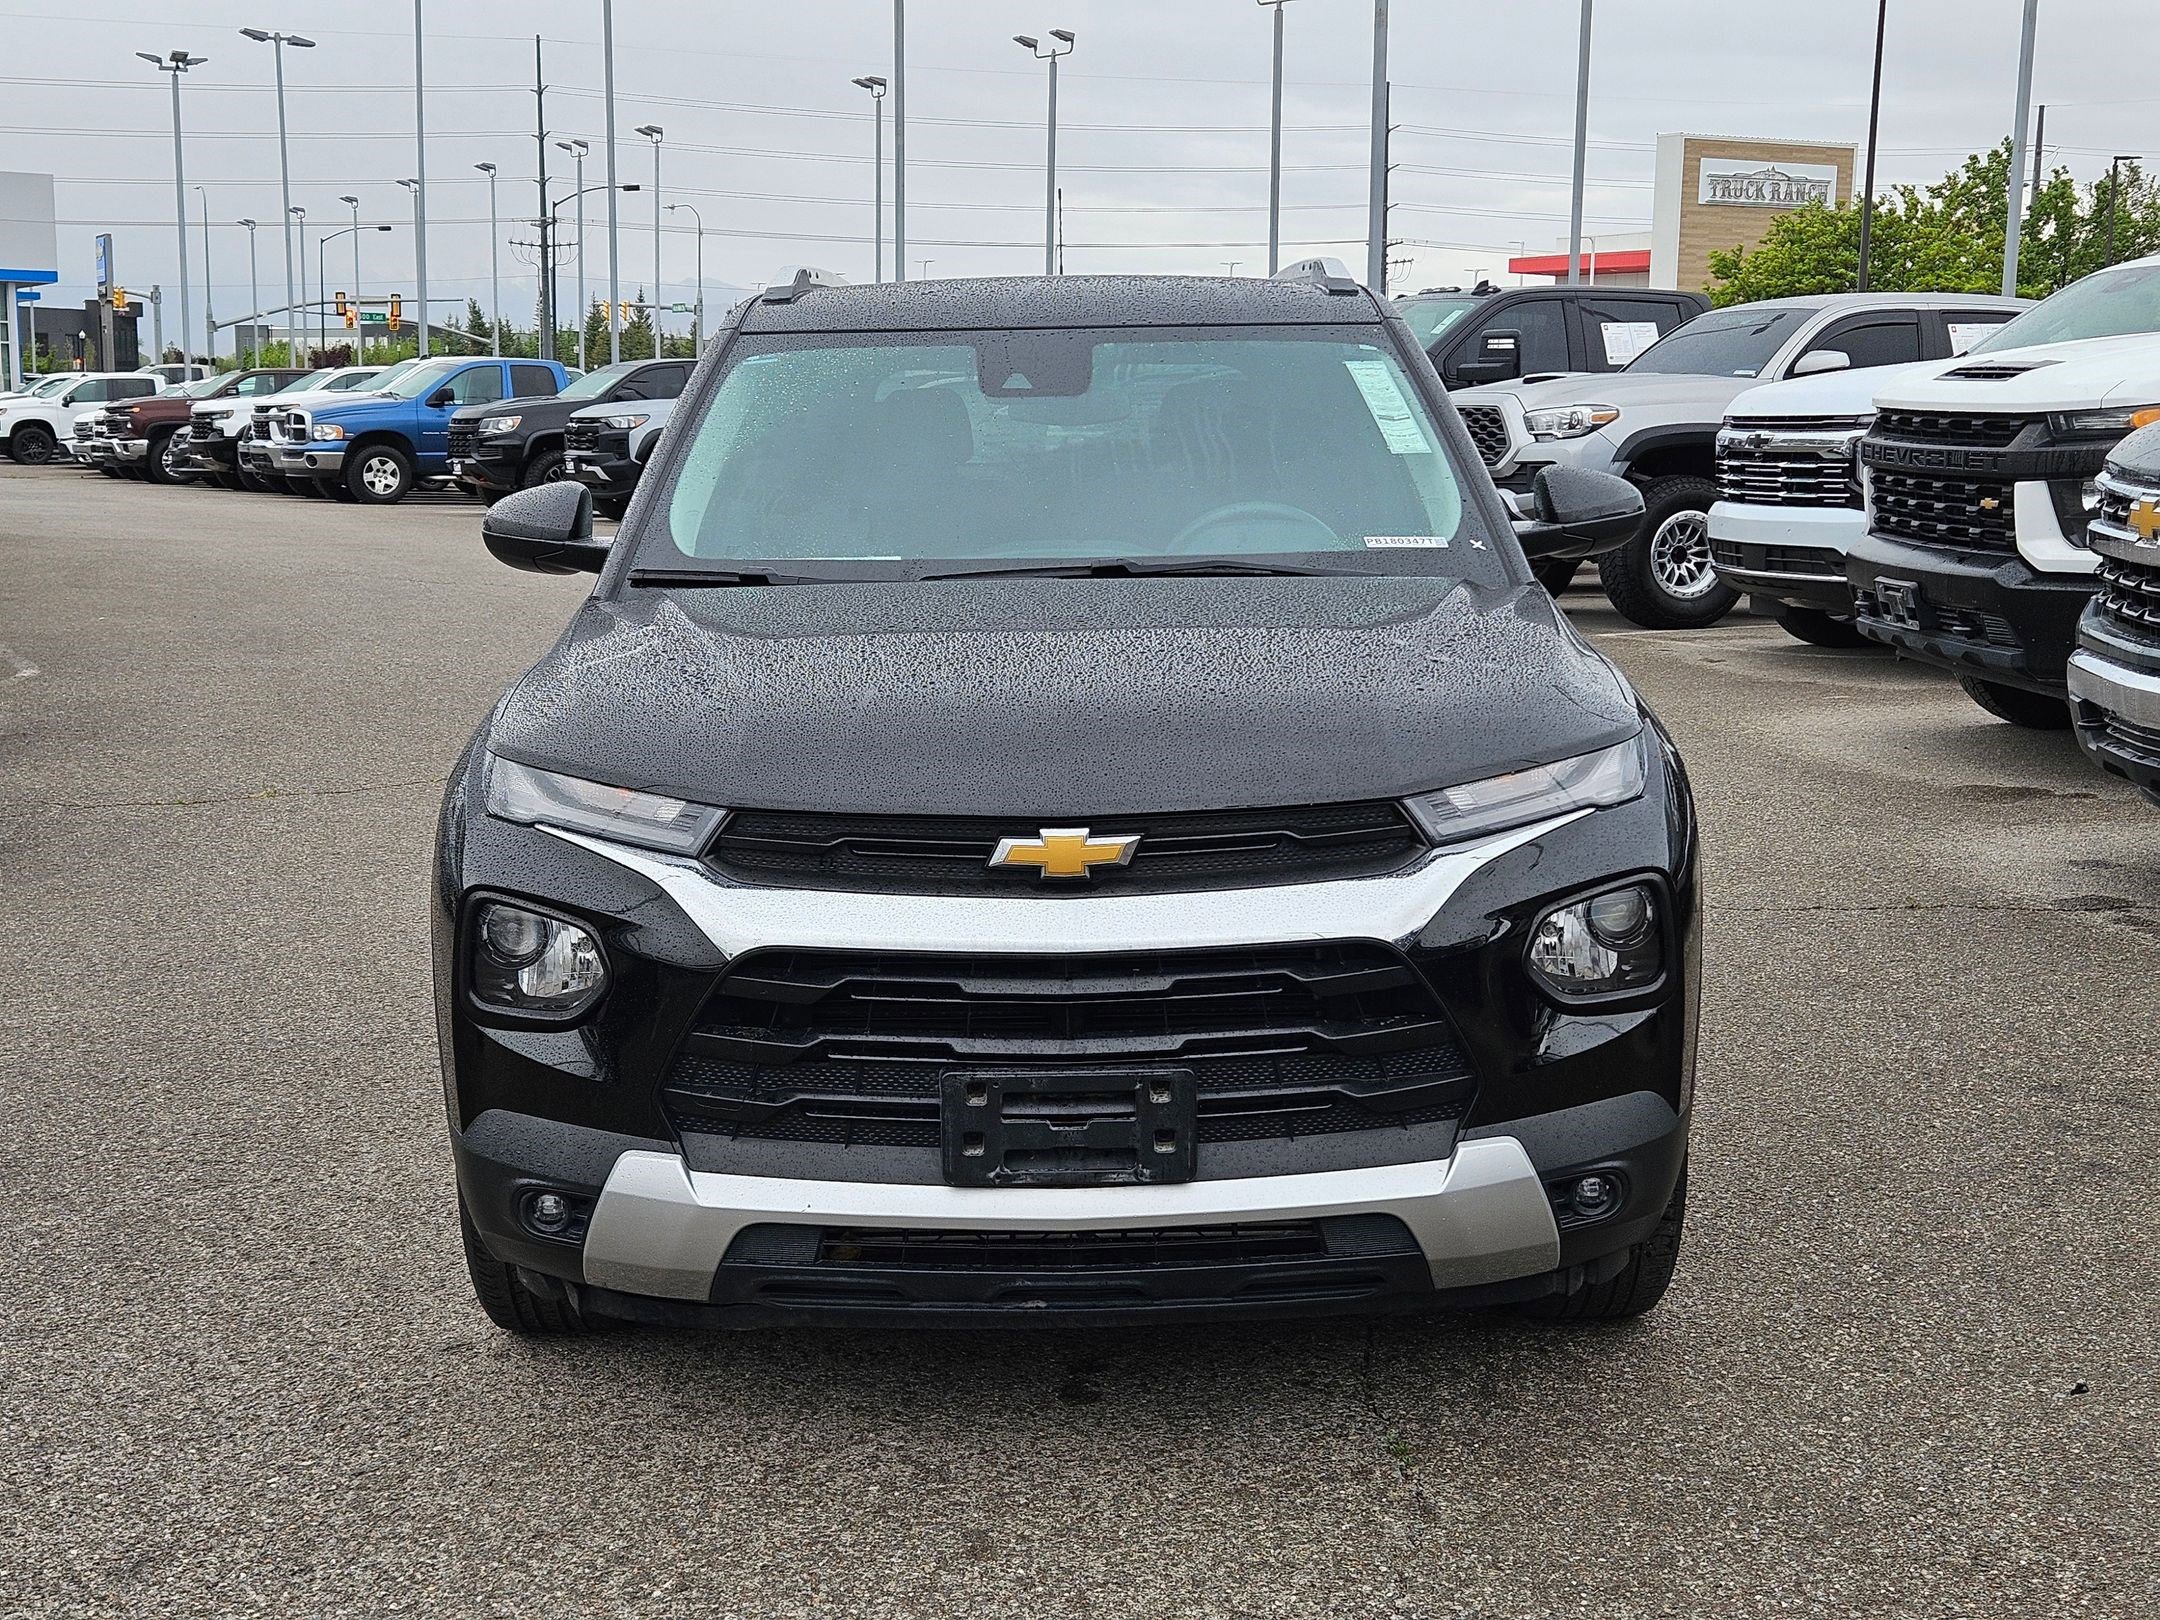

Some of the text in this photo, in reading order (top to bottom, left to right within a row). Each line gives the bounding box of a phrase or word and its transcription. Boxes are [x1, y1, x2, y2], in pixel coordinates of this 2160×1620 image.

[1708, 178, 1829, 203] TRUCK RANCH
[1861, 442, 2007, 472] CHEVROLET
